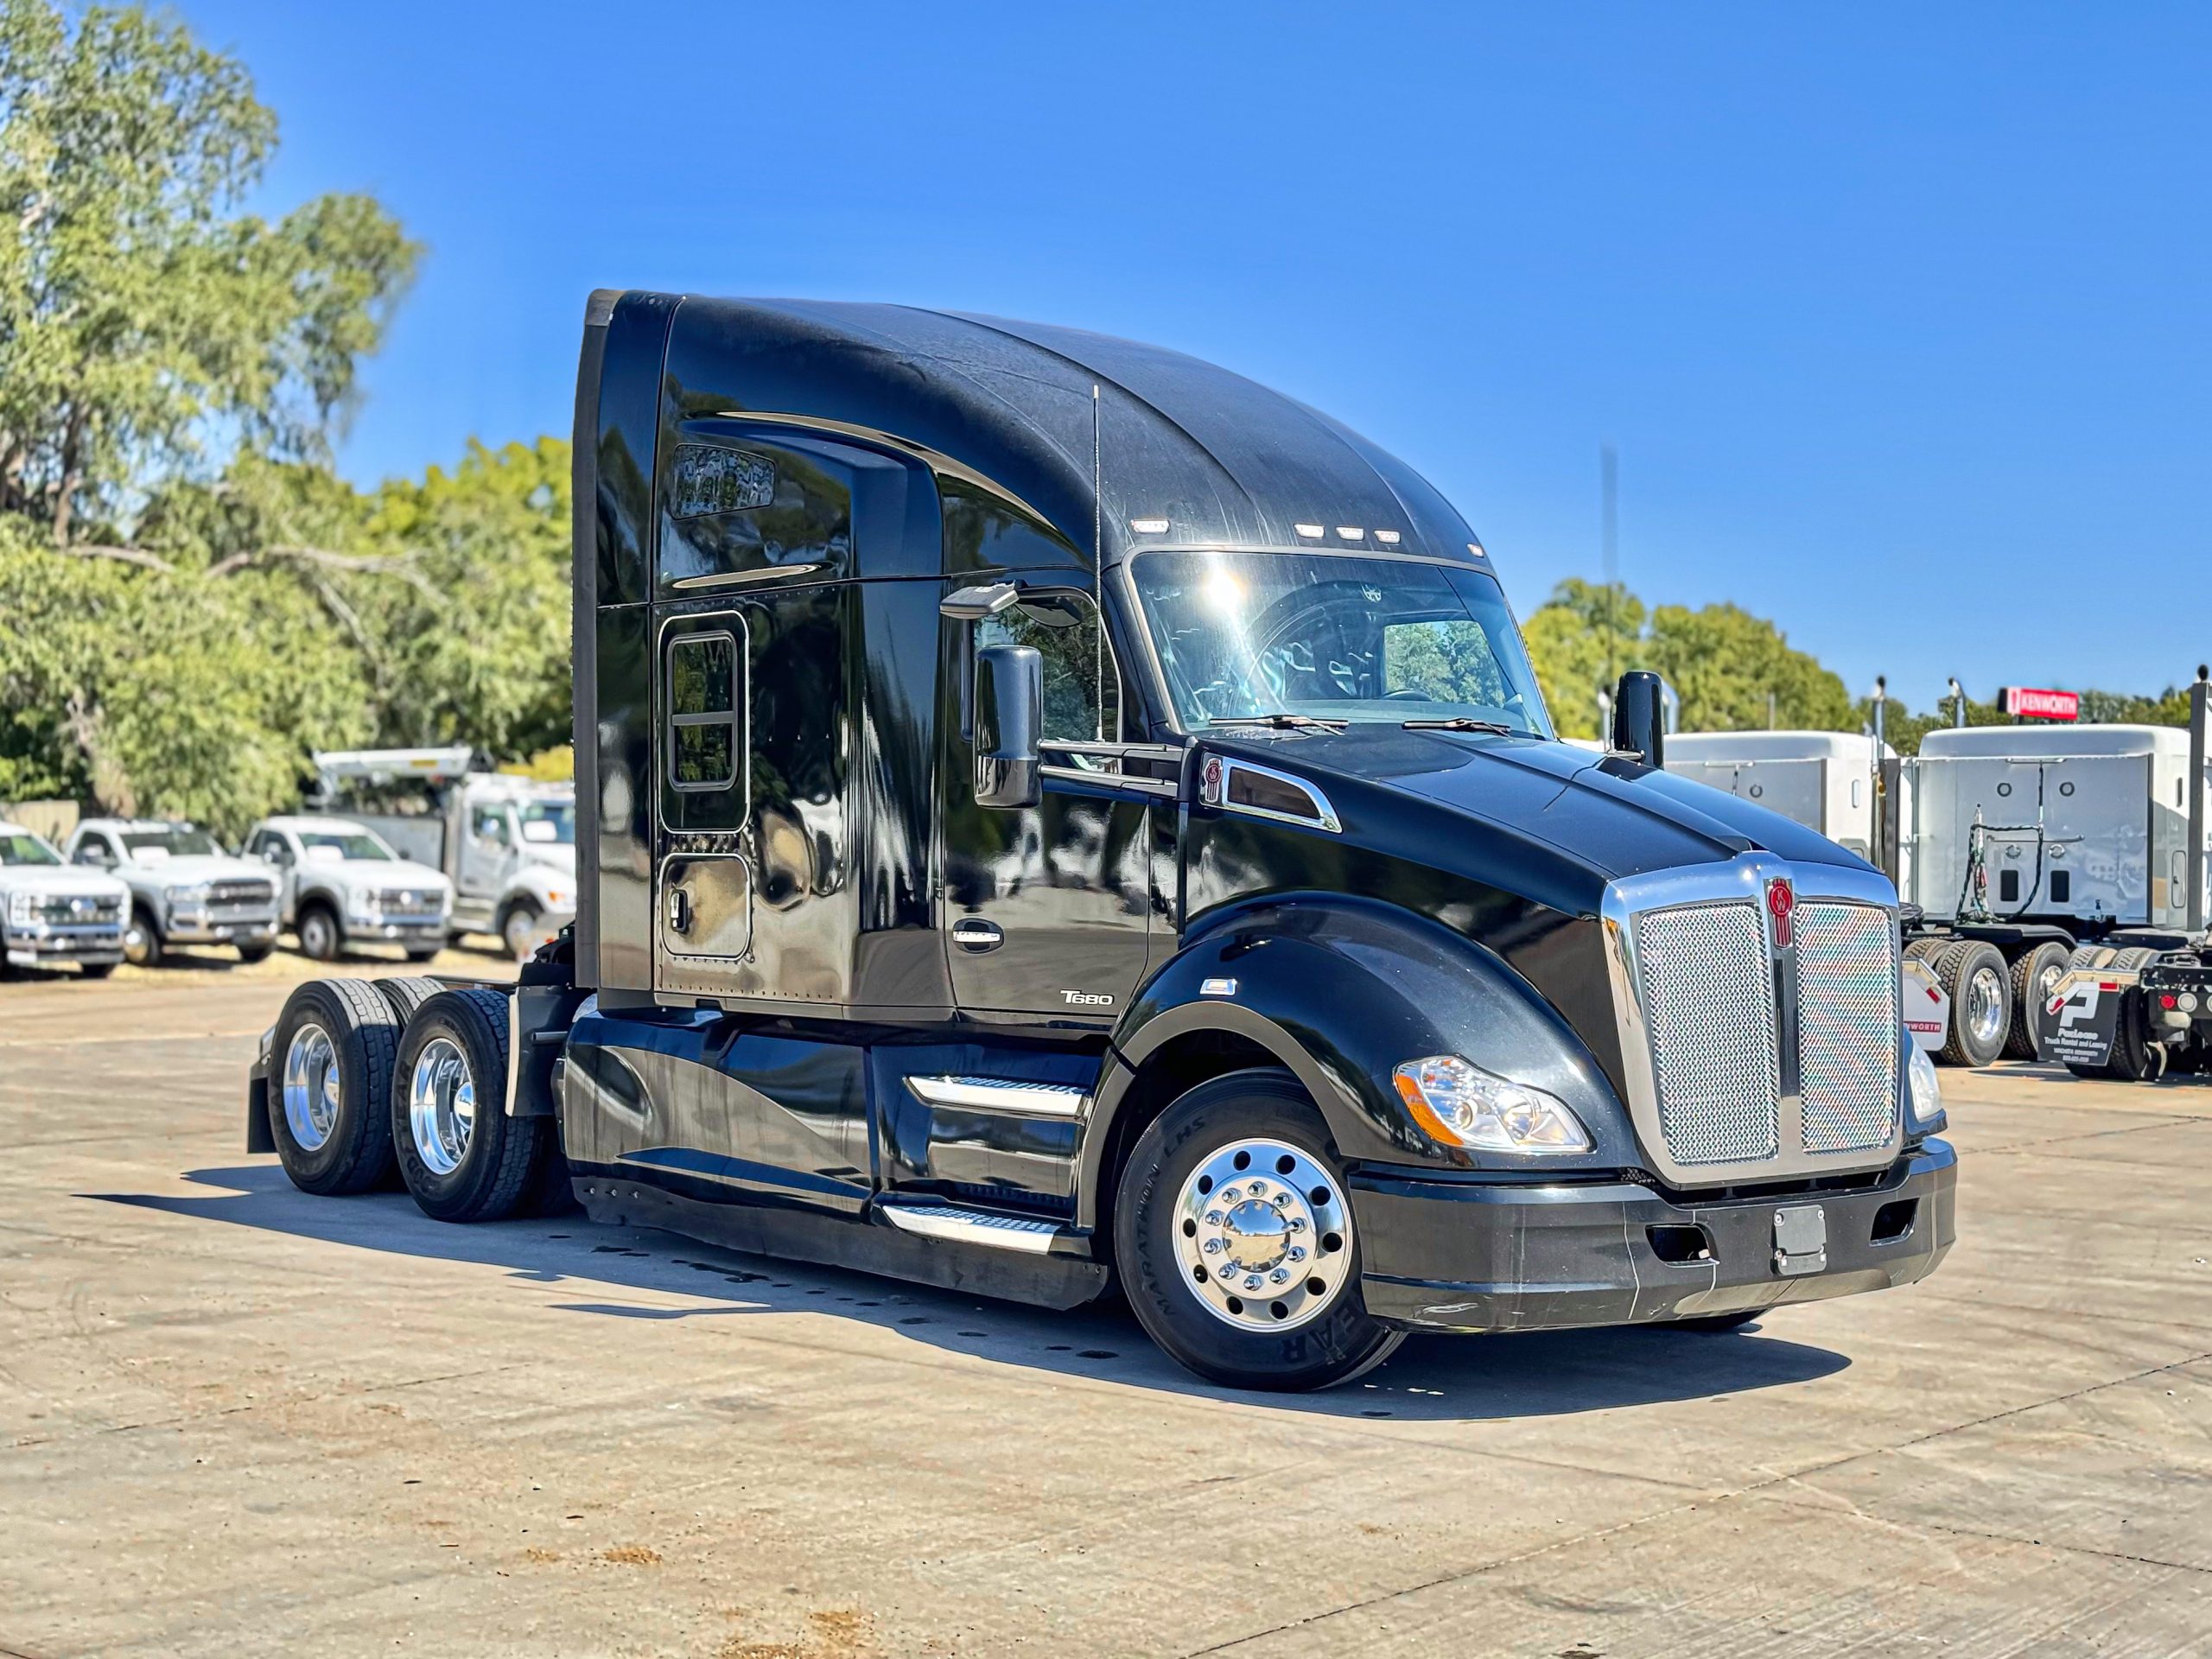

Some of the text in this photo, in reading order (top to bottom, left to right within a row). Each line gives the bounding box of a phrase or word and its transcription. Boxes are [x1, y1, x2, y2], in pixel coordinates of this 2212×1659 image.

[2022, 694, 2077, 714] KENWORTH
[1060, 990, 1113, 1005] T680
[2044, 1036, 2061, 1045] Truck
[1134, 1160, 1176, 1319] MARATHON
